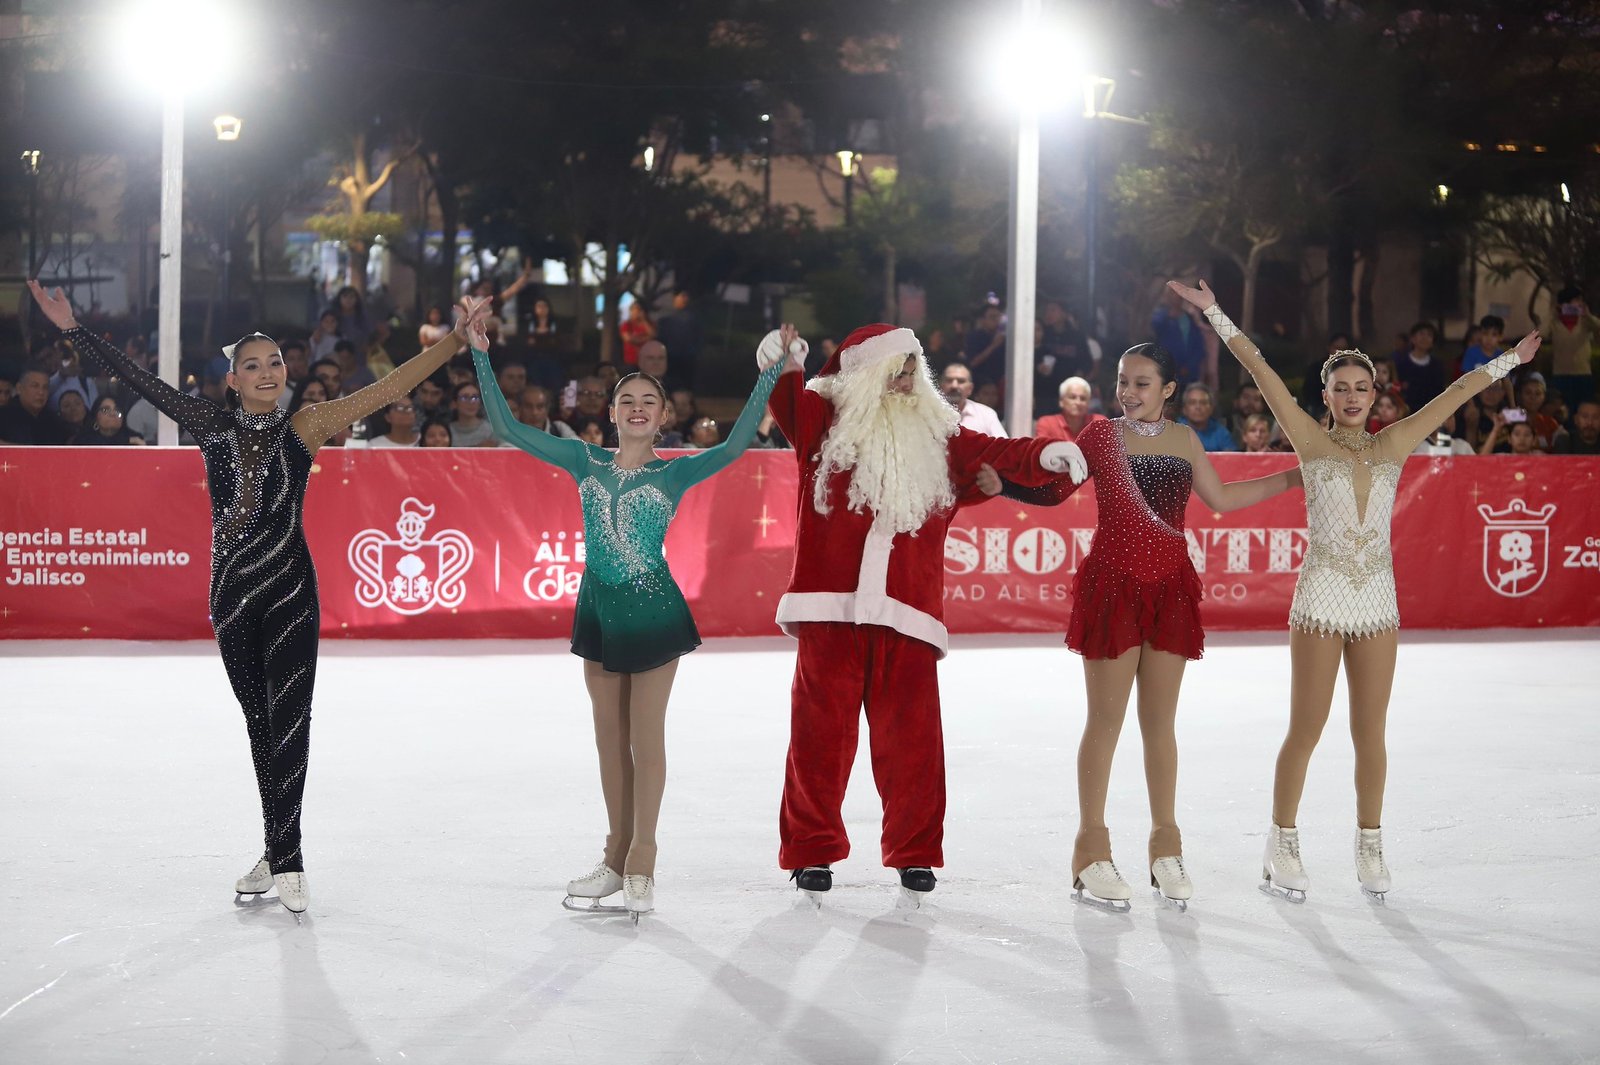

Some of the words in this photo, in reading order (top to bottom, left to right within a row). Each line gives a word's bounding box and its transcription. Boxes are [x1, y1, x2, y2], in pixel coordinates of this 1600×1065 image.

[69, 527, 147, 546] Estatal
[7, 547, 190, 566] Entretenimiento
[1563, 545, 1600, 572] Za
[5, 567, 86, 585] Jalisco
[998, 584, 1025, 601] AL
[1040, 583, 1074, 601] ES
